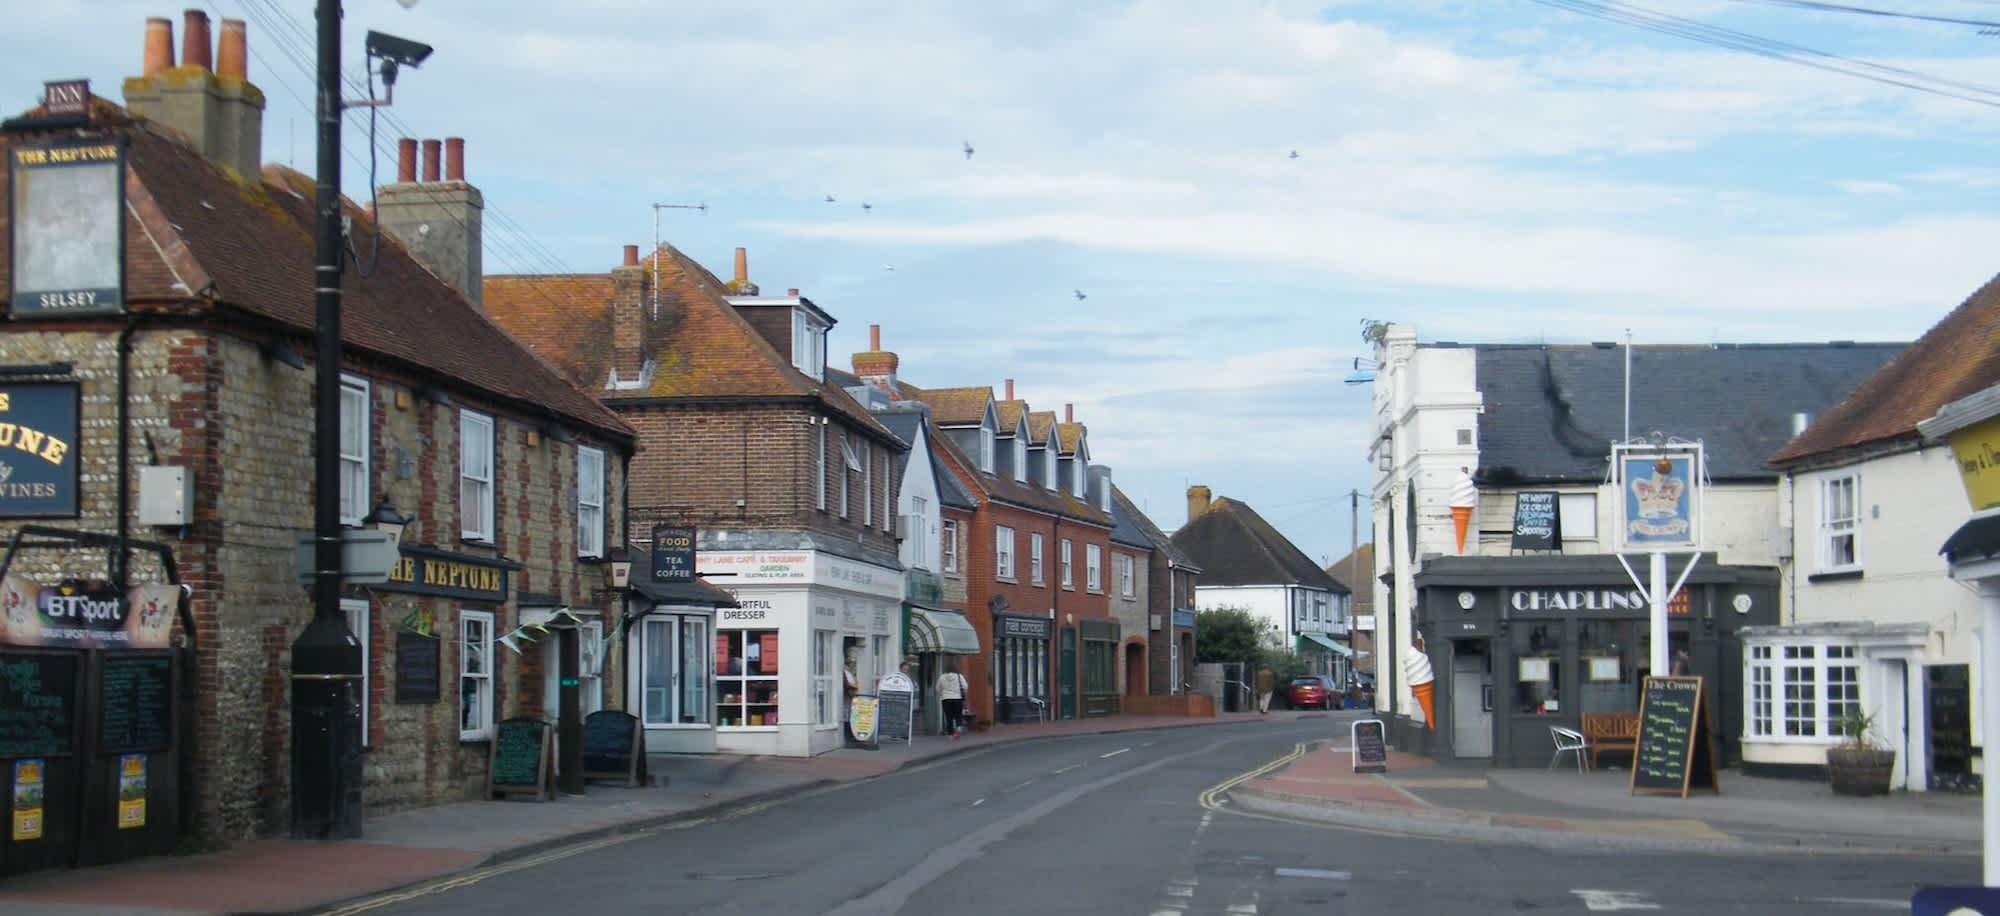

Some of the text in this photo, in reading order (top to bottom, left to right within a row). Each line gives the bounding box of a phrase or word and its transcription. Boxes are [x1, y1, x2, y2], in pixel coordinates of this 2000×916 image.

[48, 84, 81, 104] INN
[16, 145, 117, 164] THE NEPTUNE
[40, 292, 96, 306] SELSEY
[660, 537, 690, 547] FOOD
[665, 556, 684, 565] TEA
[423, 559, 500, 592] NEPTUNE
[656, 570, 690, 578] COFFEE
[1511, 591, 1644, 610] CHAPLINS
[48, 595, 121, 624] BT Sport
[724, 611, 765, 620] DRESSER
[1648, 681, 1697, 691] The Crown
